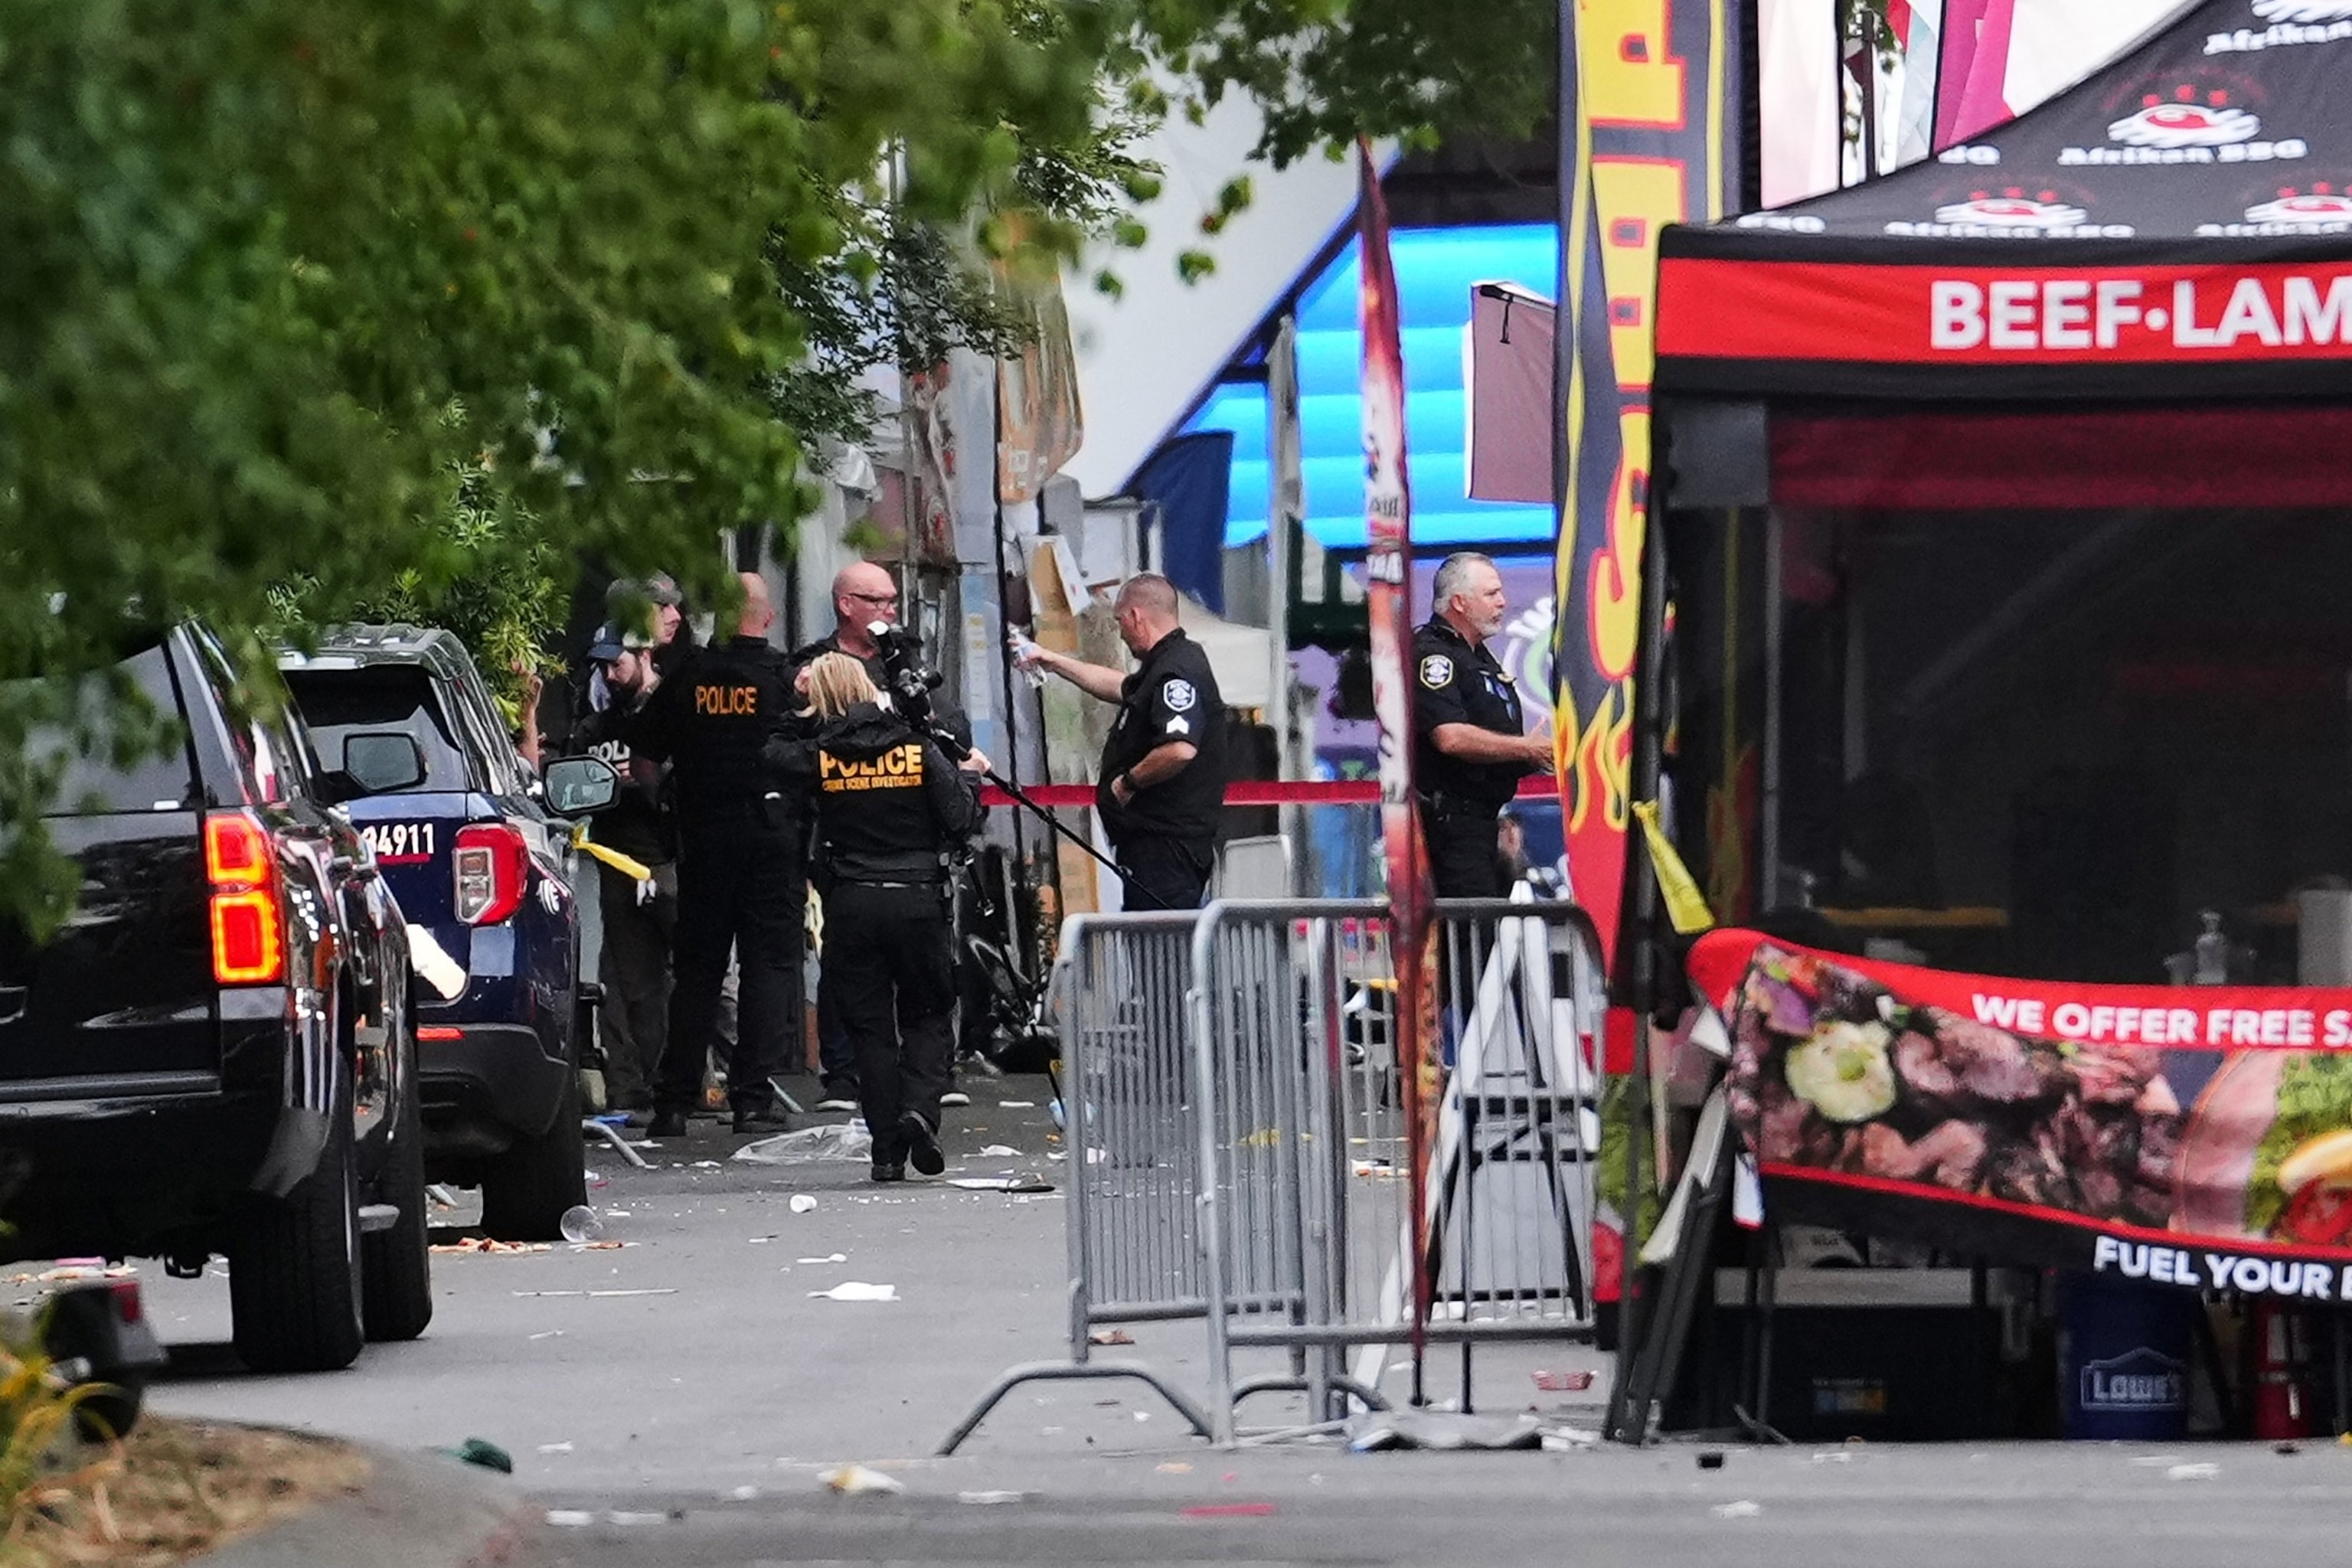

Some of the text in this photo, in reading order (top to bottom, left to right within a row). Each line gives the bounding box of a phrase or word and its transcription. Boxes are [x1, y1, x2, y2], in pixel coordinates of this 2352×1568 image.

[695, 685, 757, 714] POLICE
[1971, 995, 2352, 1047] WE OFFER FREE S
[2093, 1235, 2201, 1286] FUEL
[2204, 1253, 2334, 1300] YOUR
[2093, 1370, 2181, 1400] LOWE'
